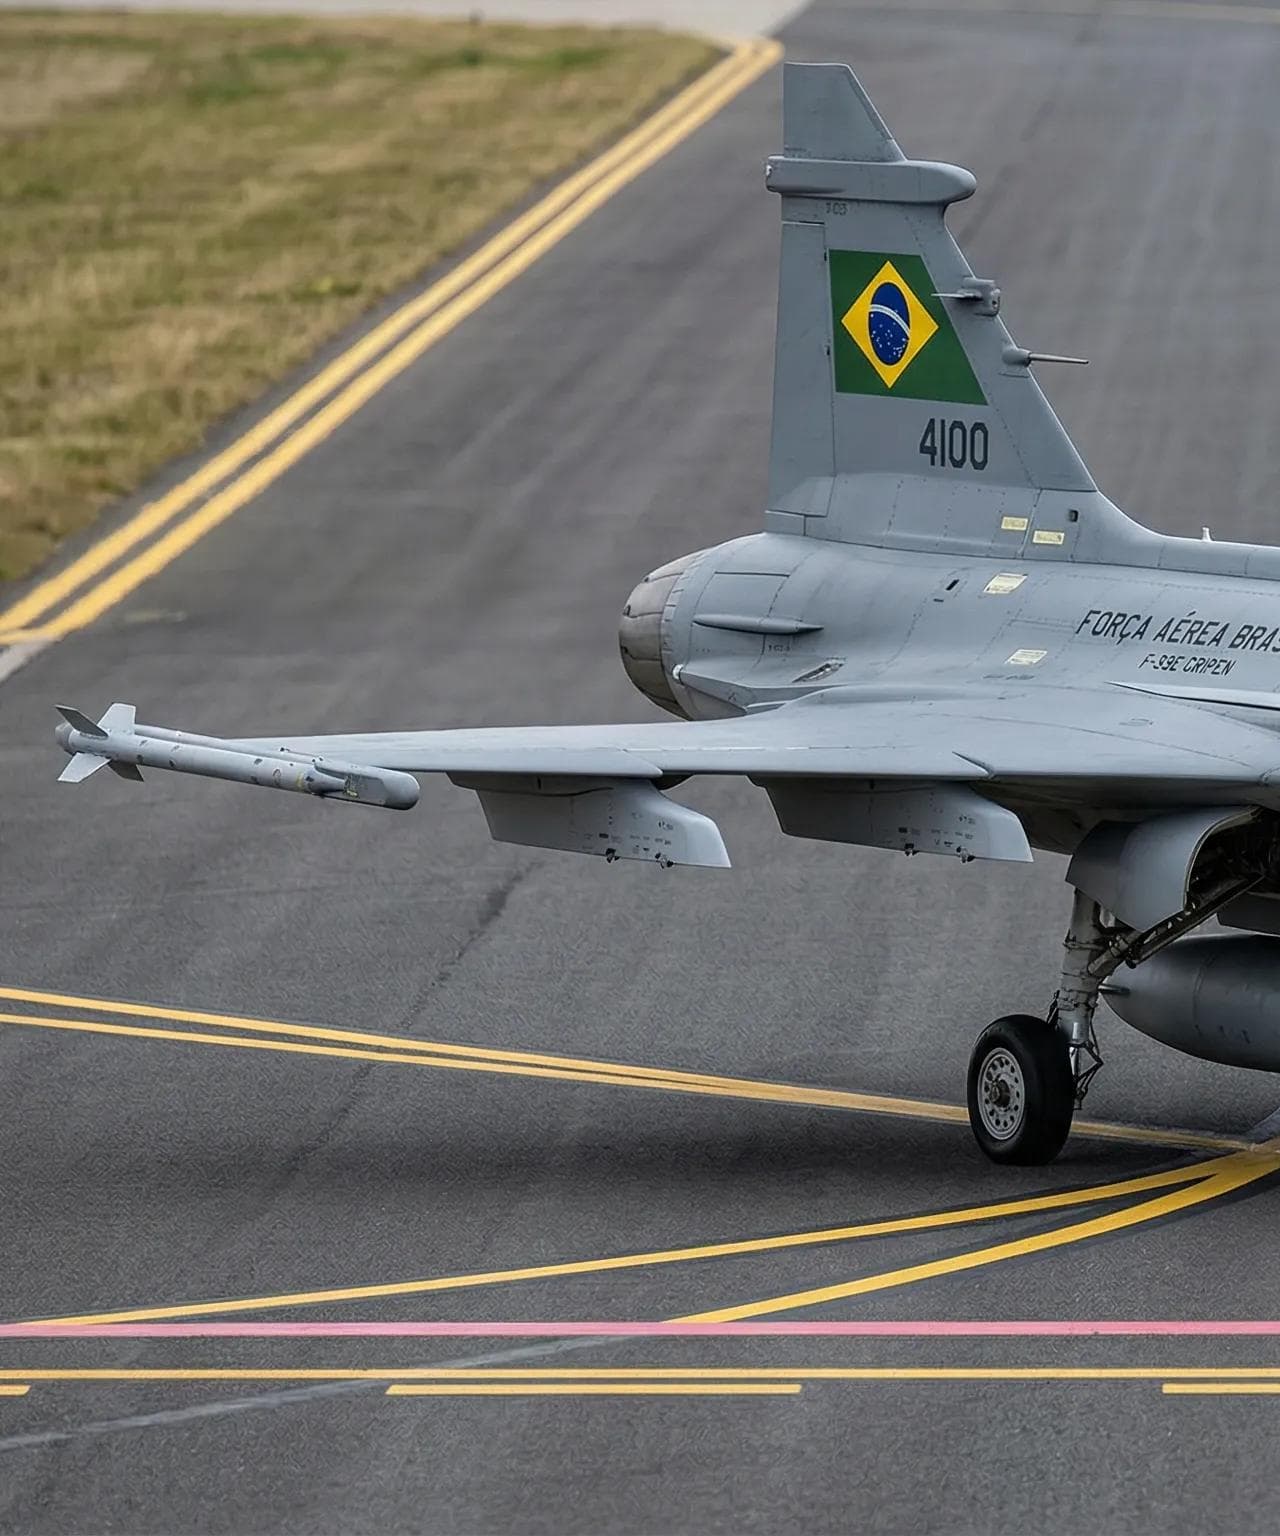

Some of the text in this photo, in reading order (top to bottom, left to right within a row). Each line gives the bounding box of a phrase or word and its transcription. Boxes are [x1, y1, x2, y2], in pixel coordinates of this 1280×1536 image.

[919, 418, 989, 470] 4100
[1075, 608, 1153, 645] FORÇA
[1152, 610, 1231, 647] AÉREA
